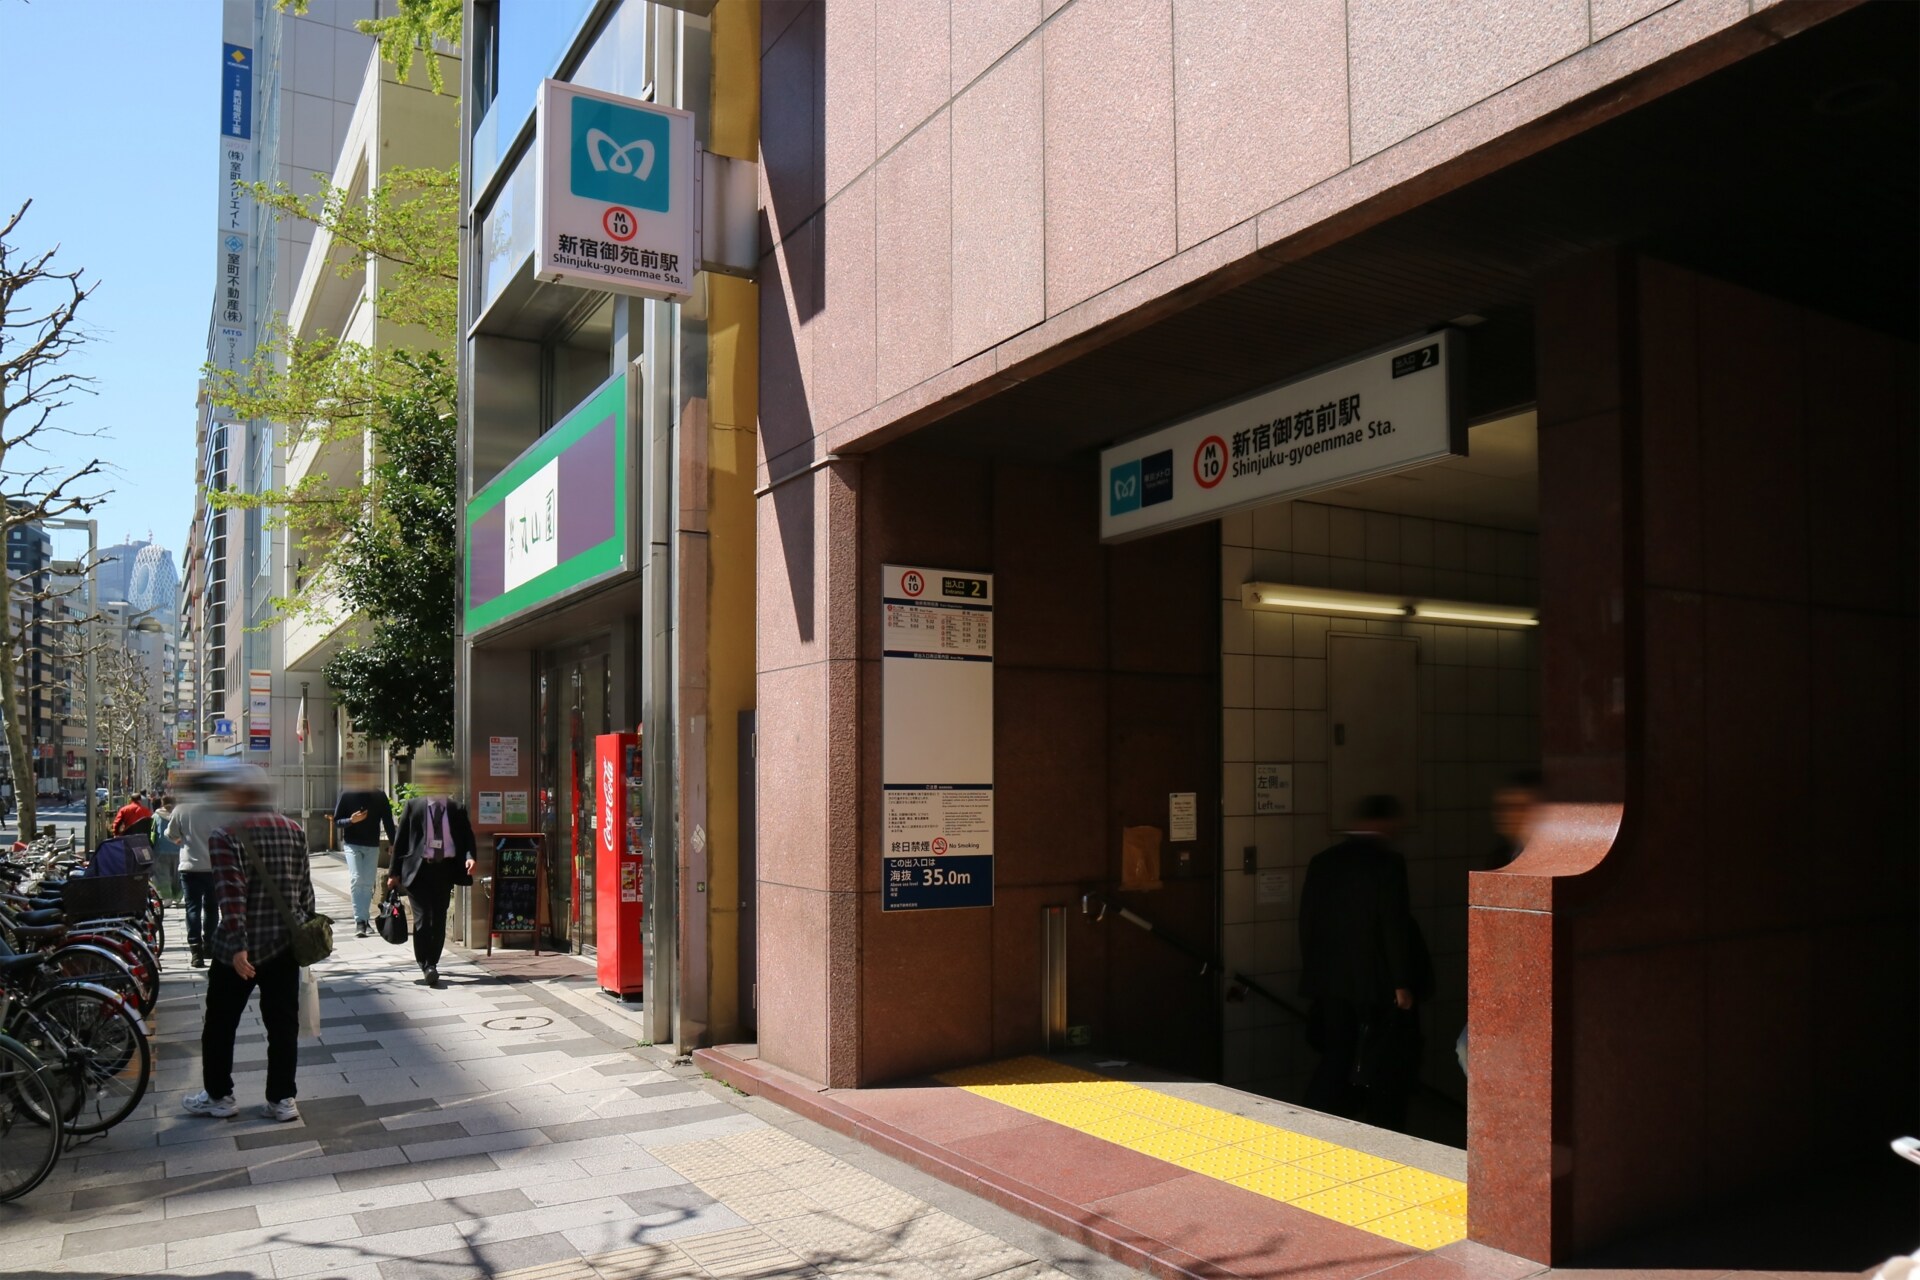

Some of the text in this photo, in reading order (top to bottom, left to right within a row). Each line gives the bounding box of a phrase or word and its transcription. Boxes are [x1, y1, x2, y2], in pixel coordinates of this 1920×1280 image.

[614, 212, 626, 223] M
[613, 222, 629, 235] 10
[558, 233, 679, 273] 新宿御苑前駅
[553, 252, 684, 285] Shinjuku-gyoemmae Sta.
[222, 328, 242, 337] MTS
[1422, 348, 1432, 367] 2
[1231, 393, 1362, 459] 新宿御苑前駅
[1204, 443, 1217, 460] M
[1231, 418, 1396, 478] Shinjuku-gyoemmae Sta.
[1202, 459, 1220, 478] 10
[908, 575, 917, 583] M
[908, 583, 919, 592] 10
[945, 580, 980, 597] 出入口 2
[603, 756, 614, 852] Coca-Cola
[1257, 800, 1273, 810] Left
[891, 840, 930, 853] 終日禁煙
[890, 858, 936, 868] この出入口は
[890, 868, 971, 886] 海抜 35.0m
